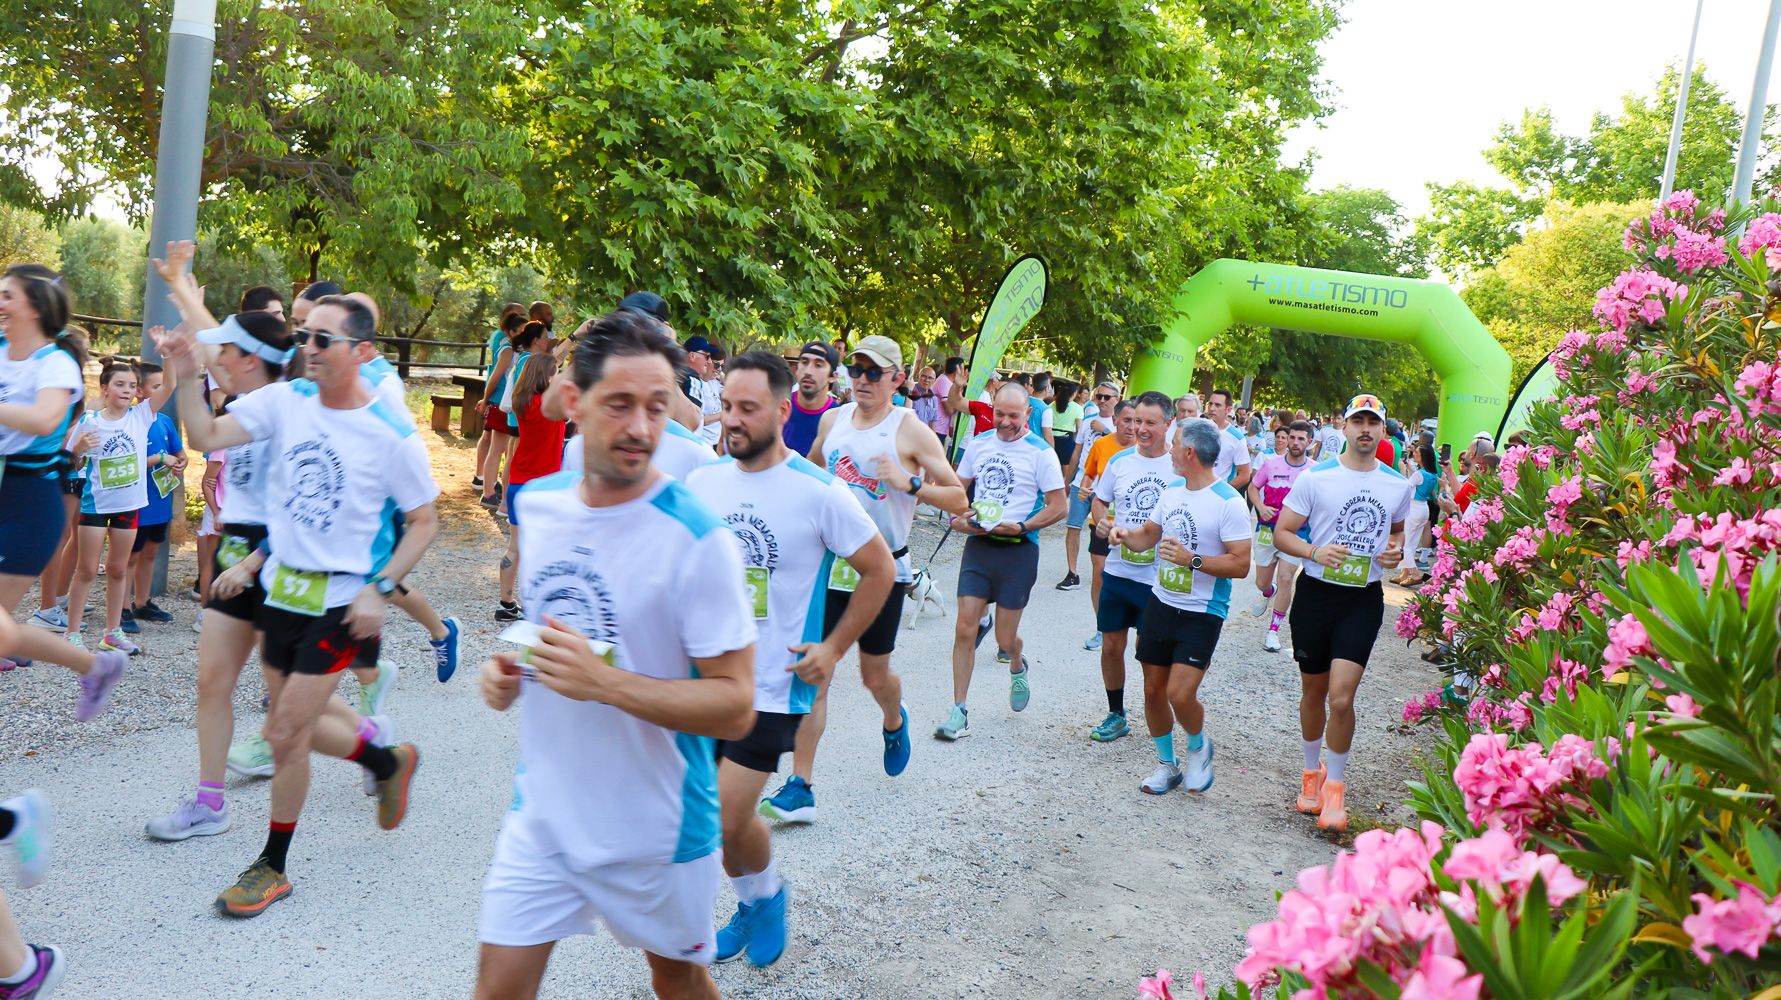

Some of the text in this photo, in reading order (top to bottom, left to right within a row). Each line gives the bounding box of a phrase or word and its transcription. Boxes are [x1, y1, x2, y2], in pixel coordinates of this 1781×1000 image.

[1268, 297, 1379, 317] www.masatletismo.com
[106, 463, 136, 479] 253
[1127, 477, 1152, 494] CARRERA
[1340, 495, 1366, 517] CARRERA
[1367, 496, 1387, 528] MEMORIAL
[1183, 510, 1198, 541] MEMORIAL
[1163, 566, 1185, 585] 191
[282, 575, 313, 597] 57
